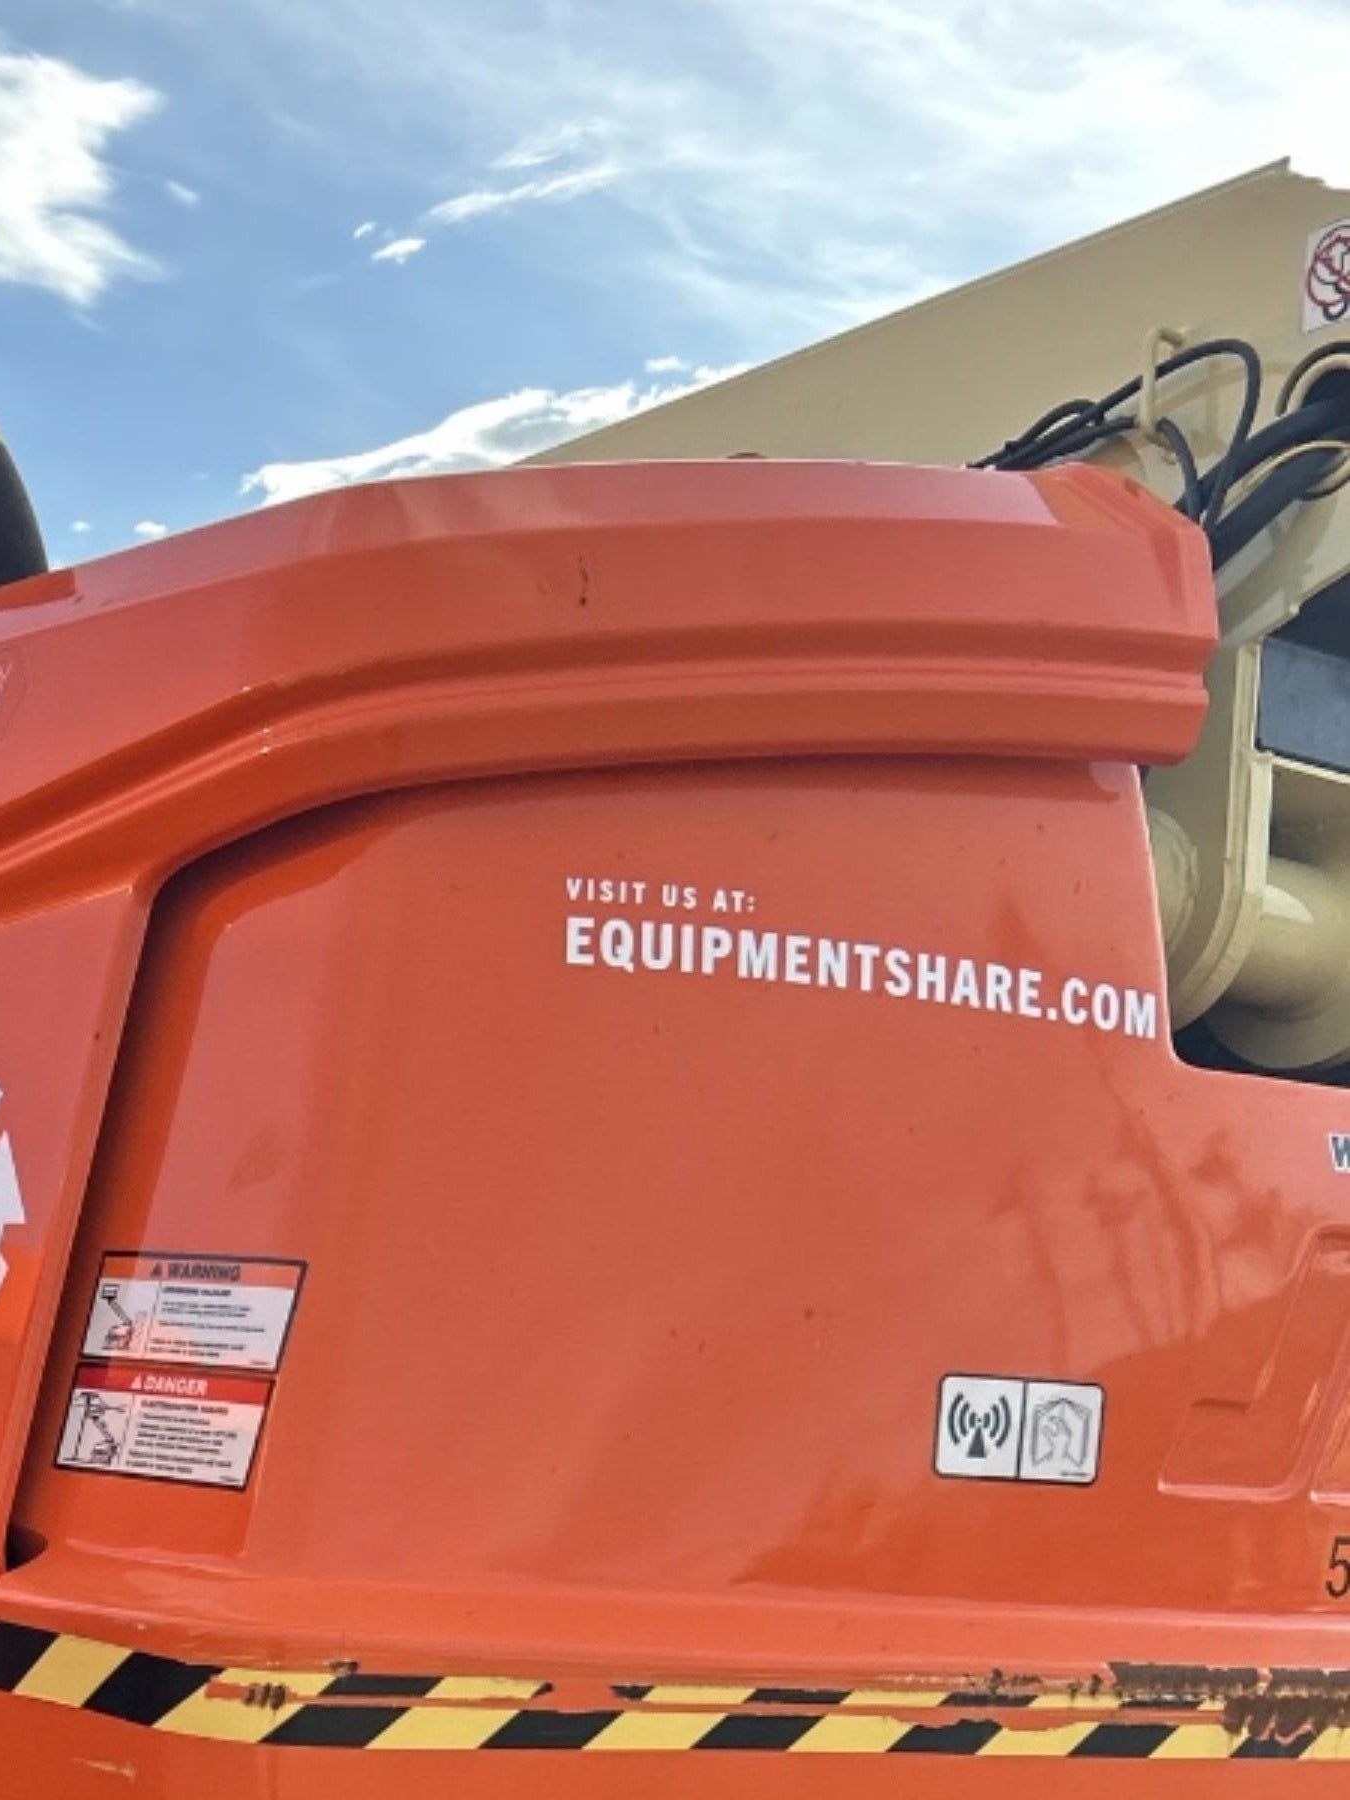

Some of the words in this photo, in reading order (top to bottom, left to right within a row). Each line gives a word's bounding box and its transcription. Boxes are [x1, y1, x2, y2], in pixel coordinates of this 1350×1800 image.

[565, 877, 647, 906] VISIT
[661, 885, 699, 910] US
[711, 889, 756, 914] AT:
[564, 915, 1157, 1040] EQUIPMENTSHARE.COM
[167, 1264, 242, 1281] WARNING
[143, 1375, 209, 1395] DANGER
